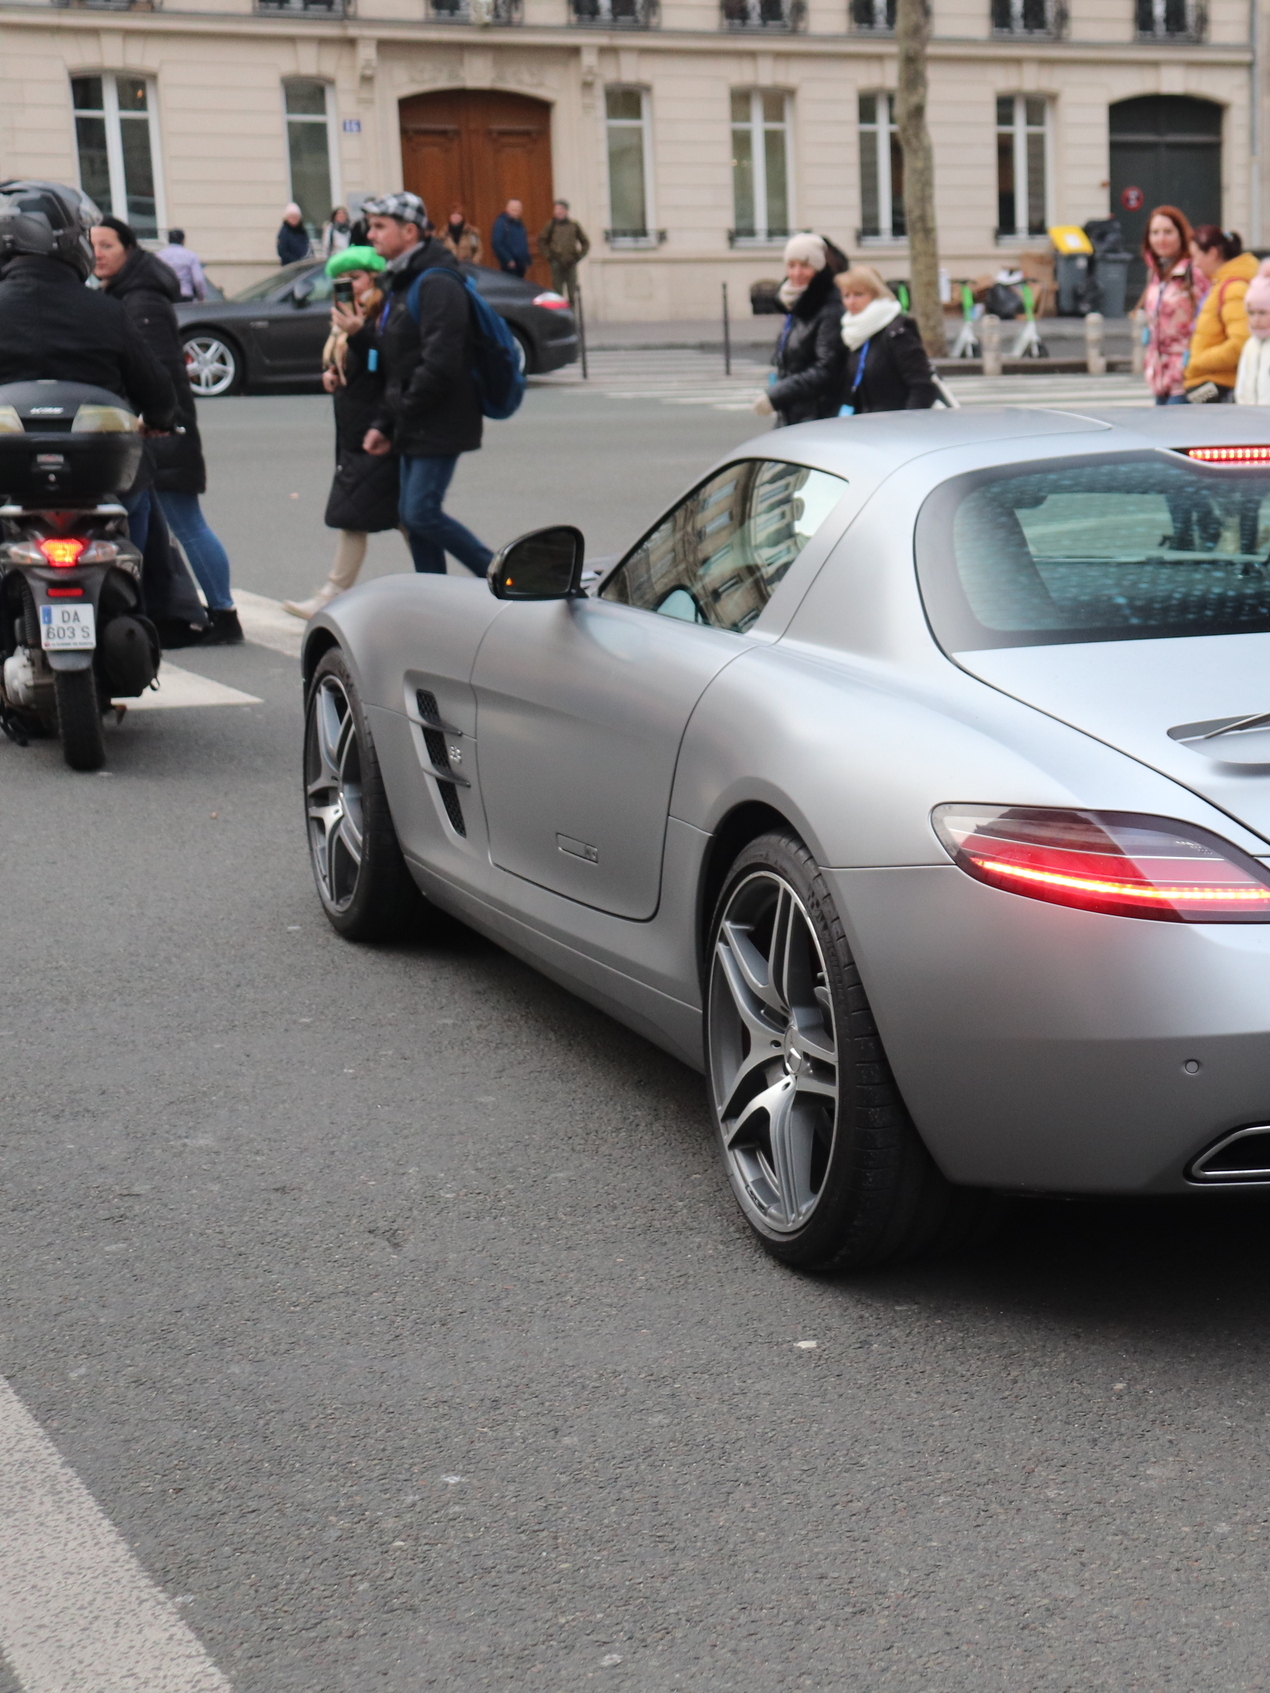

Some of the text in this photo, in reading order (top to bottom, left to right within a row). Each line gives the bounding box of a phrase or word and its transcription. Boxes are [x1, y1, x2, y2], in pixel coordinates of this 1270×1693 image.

[61, 609, 81, 624] DA
[46, 625, 90, 640] 603 S
